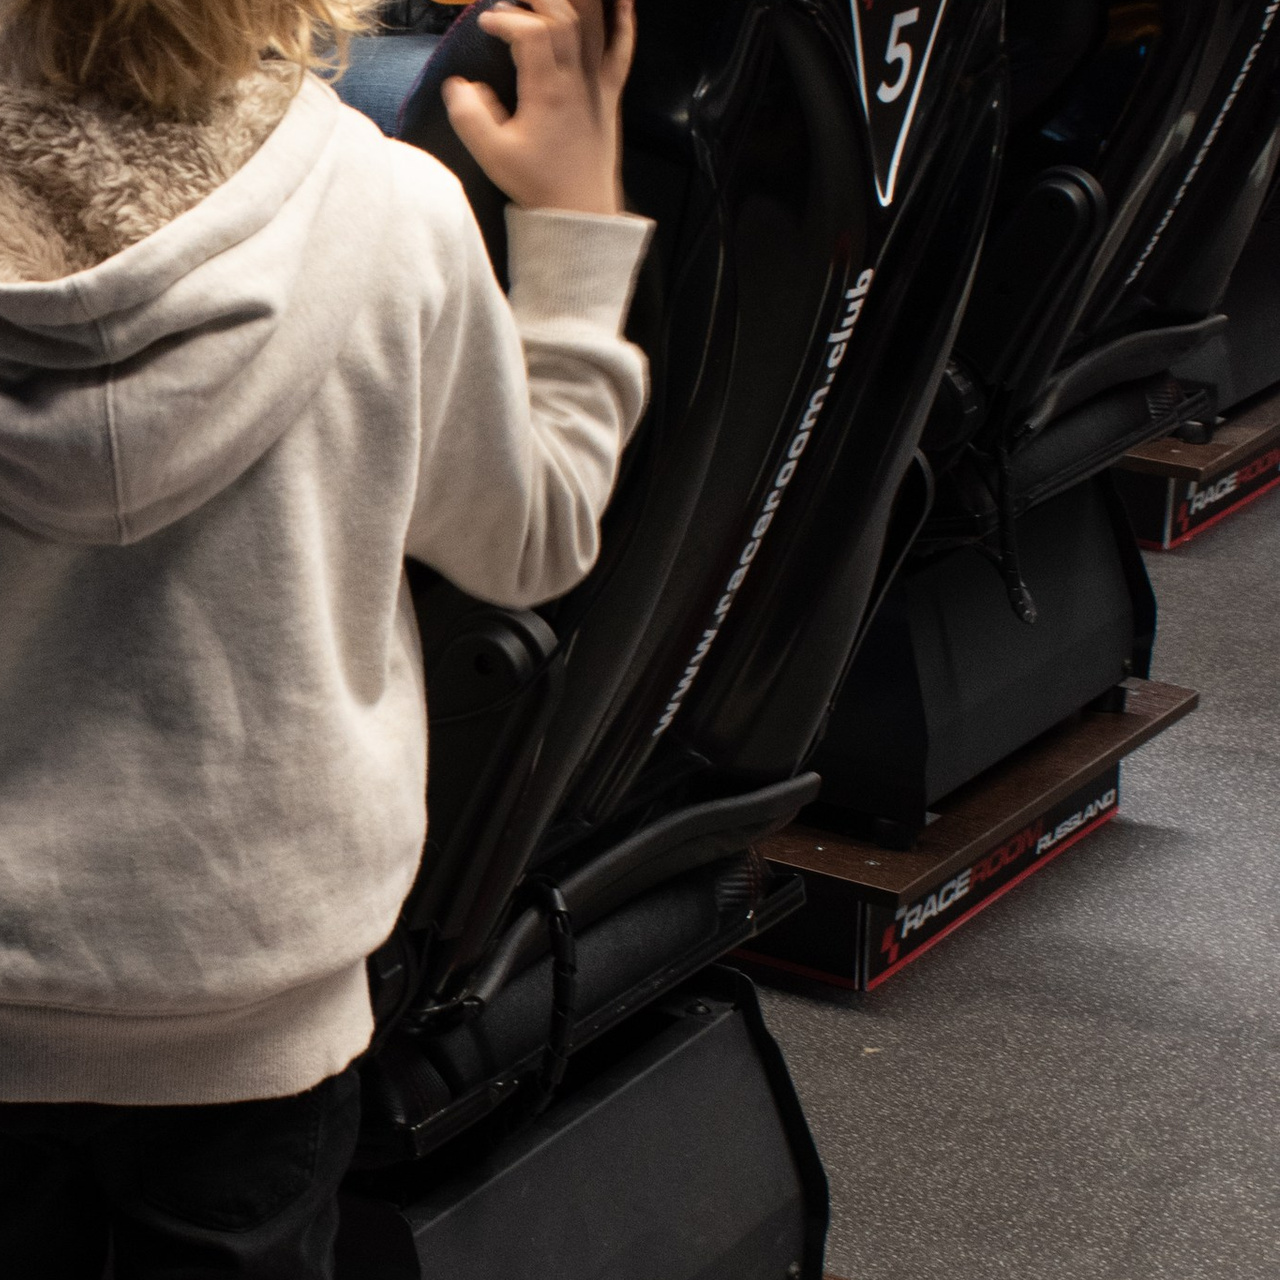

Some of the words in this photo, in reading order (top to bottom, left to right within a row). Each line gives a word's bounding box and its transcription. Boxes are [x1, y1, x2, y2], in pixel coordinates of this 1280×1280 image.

[876, 6, 920, 104] 5
[652, 267, 875, 738] www.raceroom.club
[900, 817, 1045, 940] RACEROOM
[1034, 787, 1117, 855] RUSSLAND
